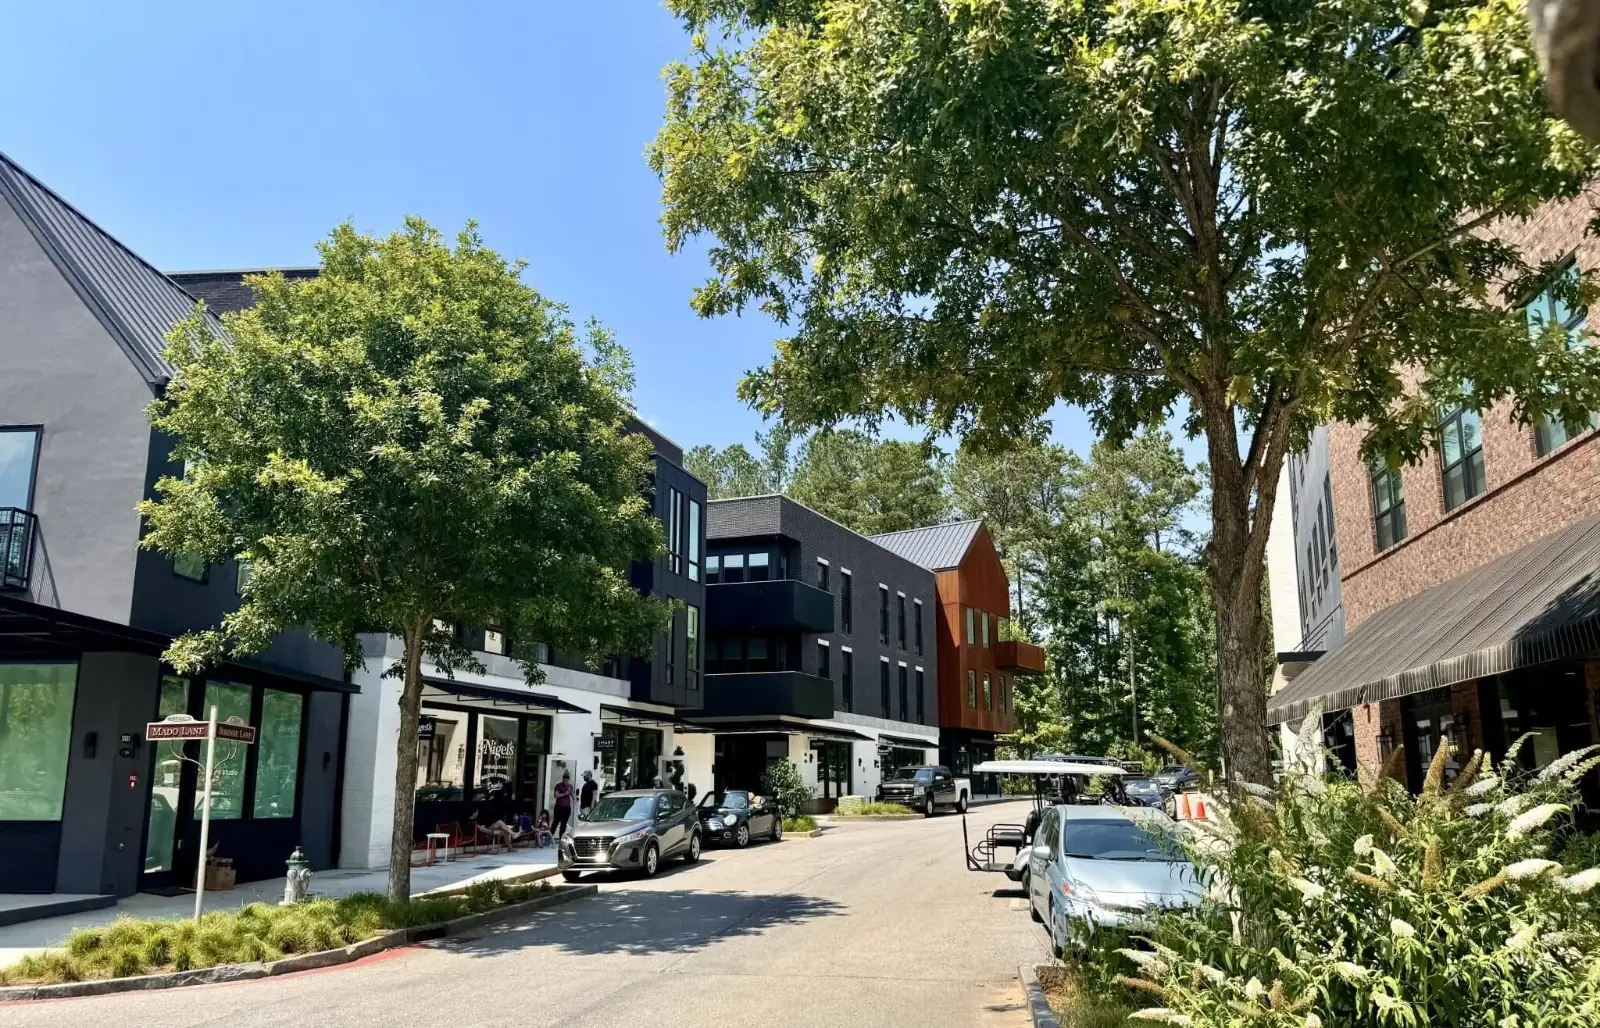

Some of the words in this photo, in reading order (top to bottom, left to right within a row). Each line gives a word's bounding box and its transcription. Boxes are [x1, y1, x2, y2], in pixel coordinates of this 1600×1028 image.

[152, 727, 179, 737] MADO
[181, 726, 205, 736] LANE
[481, 739, 515, 760] Nigel's
